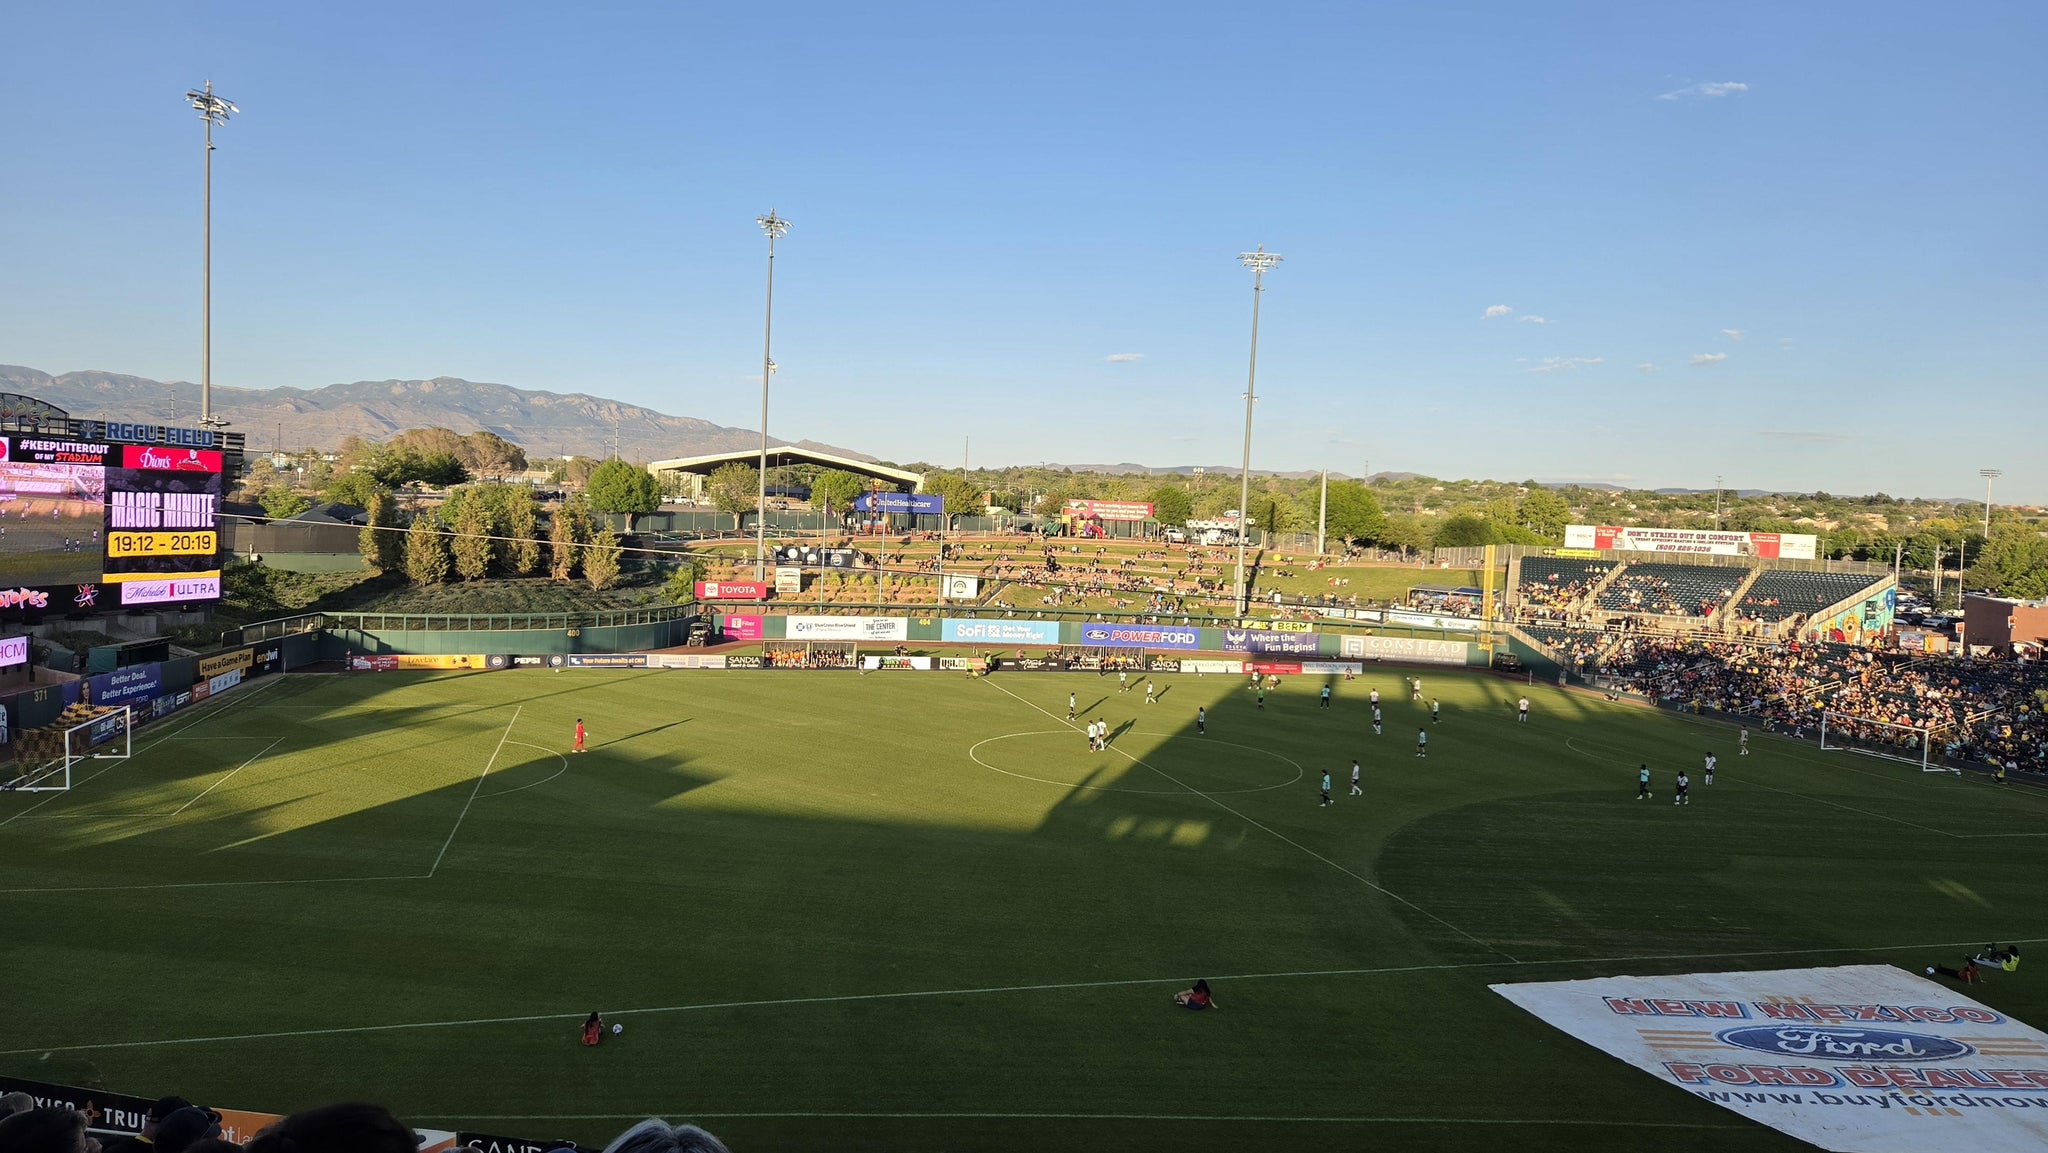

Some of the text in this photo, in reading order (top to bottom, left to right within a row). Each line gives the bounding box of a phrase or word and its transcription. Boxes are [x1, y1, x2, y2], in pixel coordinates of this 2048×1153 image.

[104, 421, 214, 447] RGCU FIELD
[20, 439, 109, 454] #KEEPLITTEROUT
[55, 452, 103, 463] STADIUM
[140, 447, 172, 469] Dion's
[112, 491, 215, 528] MAGIC MINUTE
[1627, 530, 1649, 538] DON'T
[1650, 531, 1677, 539] STRIKE
[114, 535, 154, 552] 19:12
[171, 535, 211, 550] 20:19
[125, 583, 216, 599] Michelob ULTRA
[720, 586, 757, 594] TOYOTA
[866, 622, 896, 631] THE CENTER
[956, 623, 986, 637] SoFi
[1002, 624, 1016, 632] Get
[1277, 622, 1308, 631] BERM
[567, 629, 580, 638] 400
[1002, 631, 1044, 640] Money Right
[1250, 634, 1296, 642] Where the
[1265, 643, 1316, 653] Fun Begins!
[1370, 638, 1461, 654] GONSTEAD
[202, 662, 217, 673] Have
[221, 657, 238, 667] Game
[238, 652, 251, 663] Plan
[407, 656, 440, 664] Lovelace
[728, 656, 761, 664] SANDIA
[1150, 660, 1179, 668] SANDIA
[111, 674, 131, 685] Better
[34, 689, 48, 702] 371
[102, 688, 122, 700] Better
[1602, 996, 2006, 1025] NEW MEXICO
[1776, 1029, 1927, 1056] Ford
[1663, 1061, 1844, 1088] FORD
